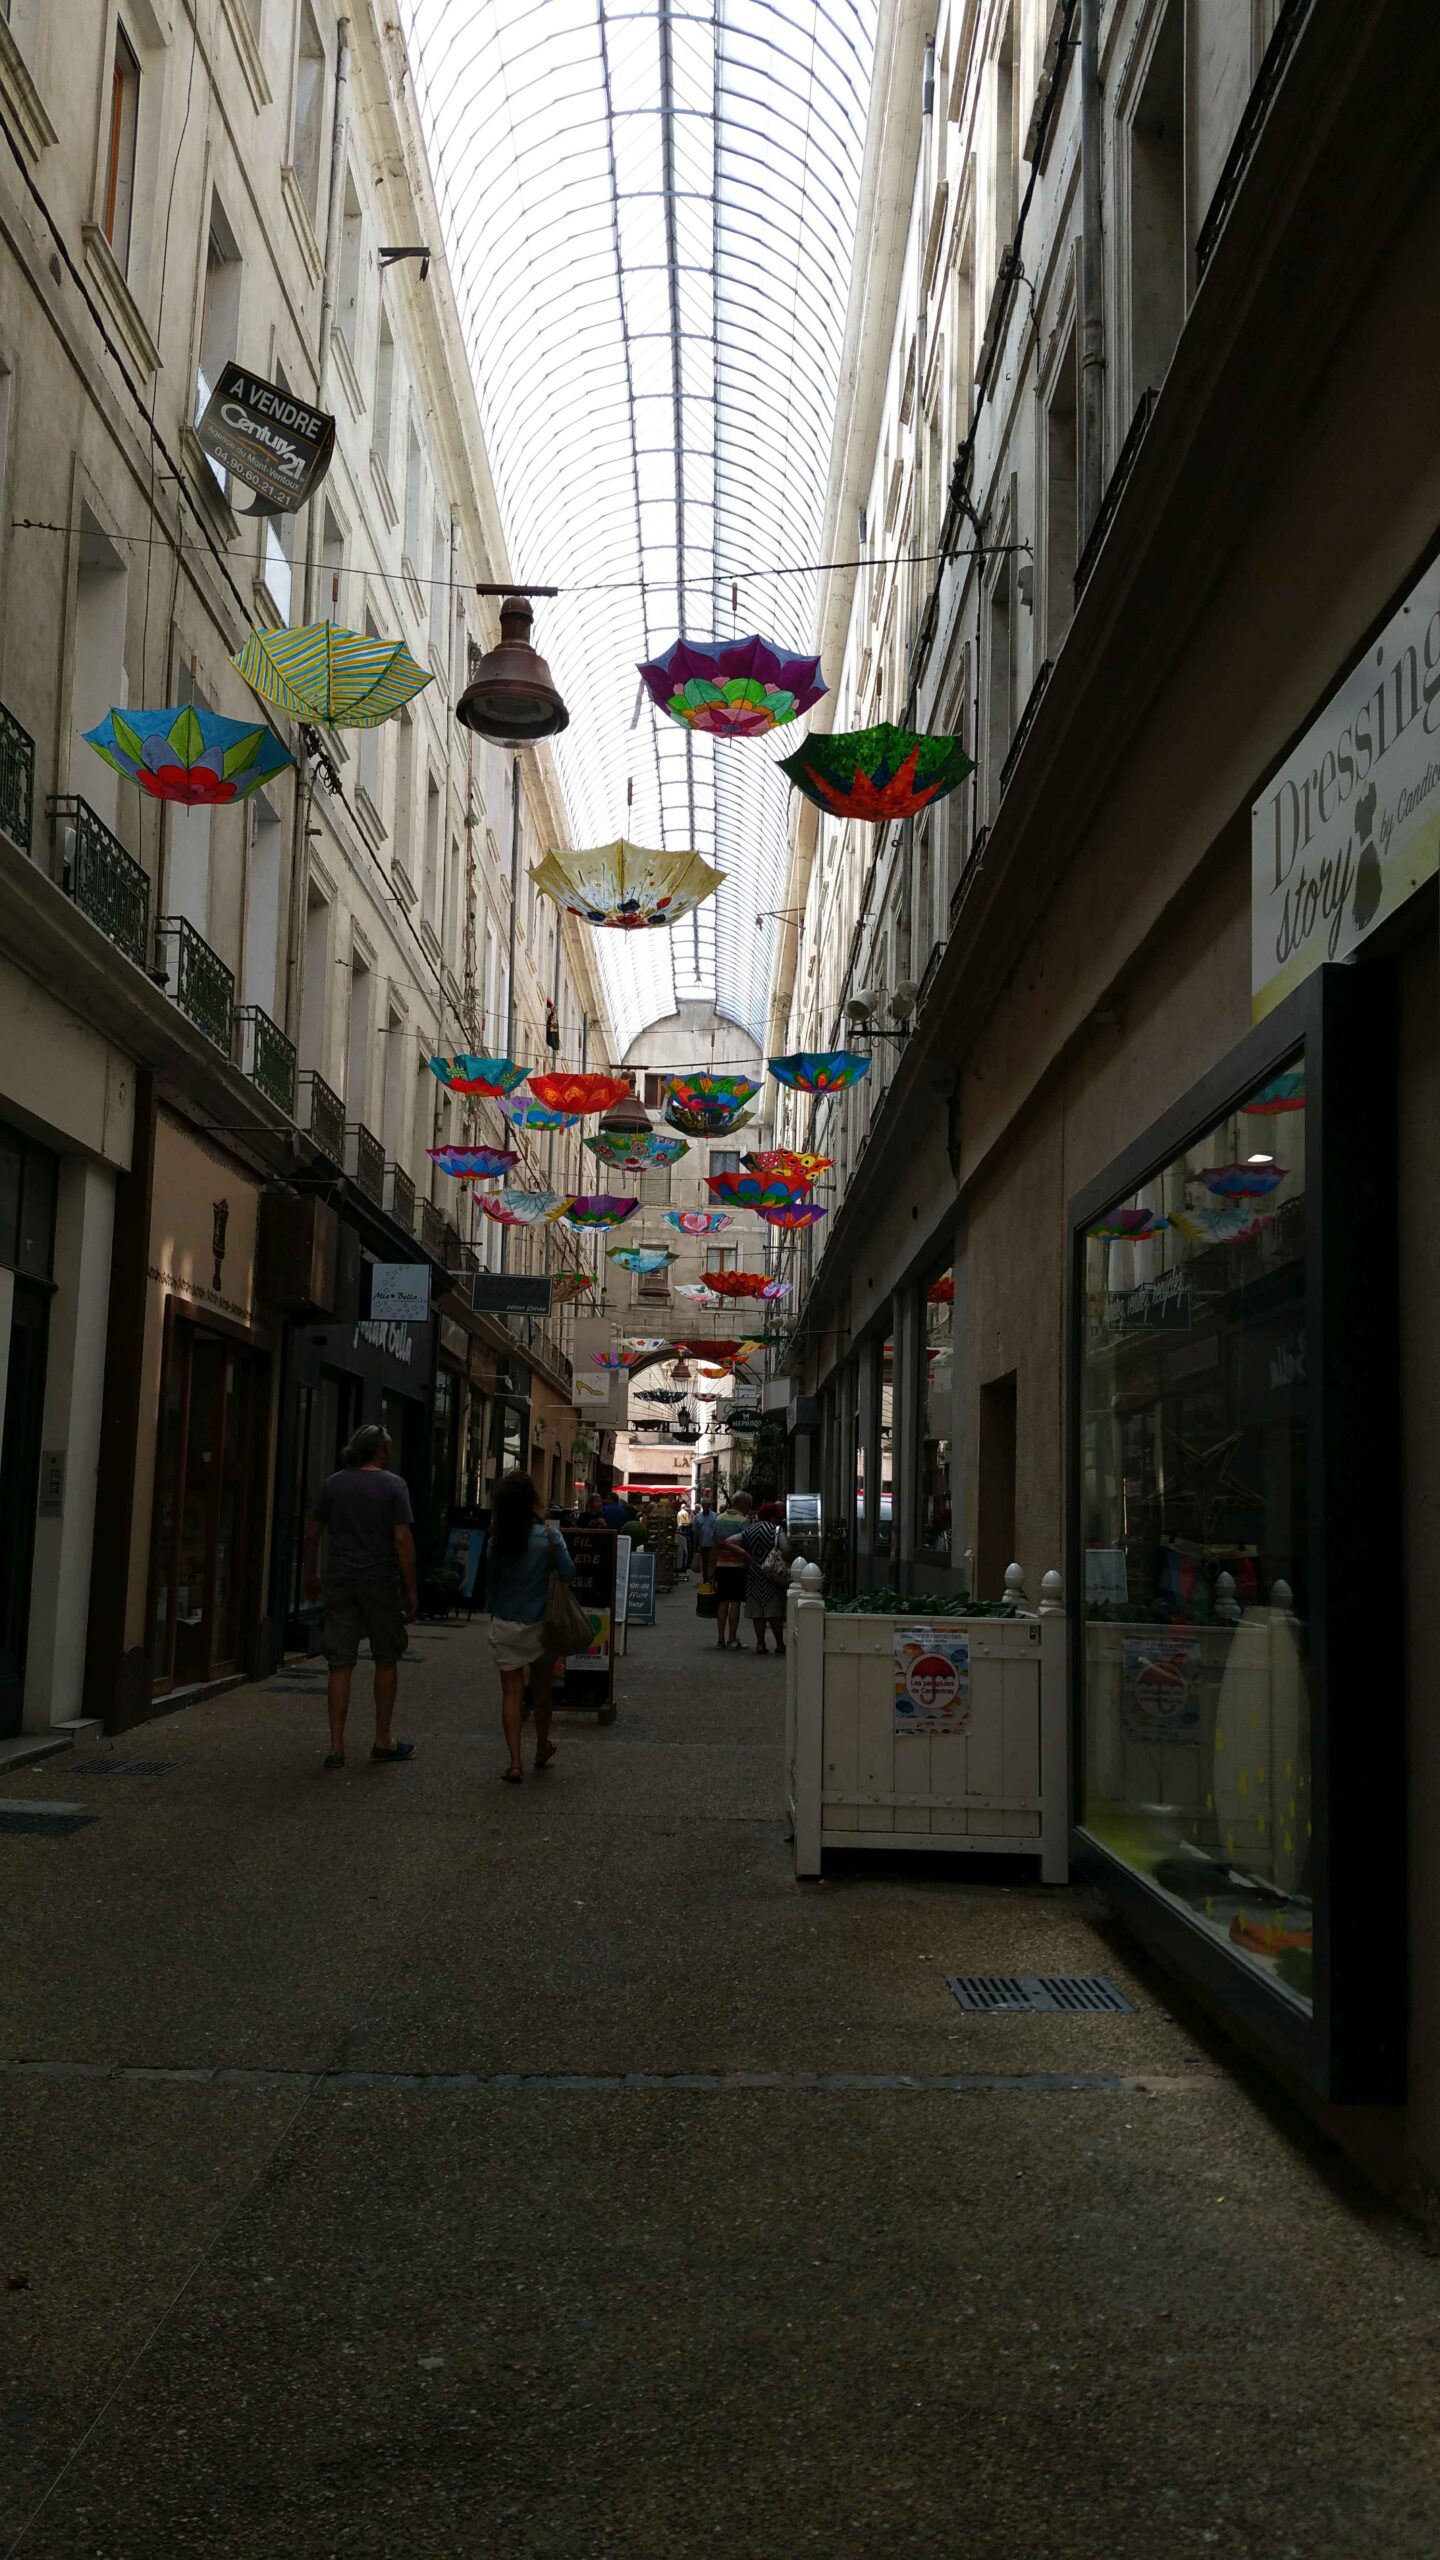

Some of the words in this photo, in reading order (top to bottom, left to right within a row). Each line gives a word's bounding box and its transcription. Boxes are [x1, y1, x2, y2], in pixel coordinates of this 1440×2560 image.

[228, 377, 245, 399] A
[249, 384, 323, 440] VENDRE
[208, 425, 237, 452] Agence
[237, 447, 247, 459] du
[247, 453, 301, 491] Mont-Ventoux
[220, 403, 296, 457] Century
[278, 452, 307, 481] 21
[214, 446, 291, 506] 04.90.60.21.21
[1380, 807, 1394, 857] by
[1397, 760, 1440, 824] Candic
[373, 1291, 390, 1300] Mia
[397, 1292, 418, 1300] Bella
[573, 1536, 593, 1548] FIL
[629, 1591, 649, 1599] ffure
[640, 1581, 651, 1590] de
[923, 1680, 955, 1688] parapluies
